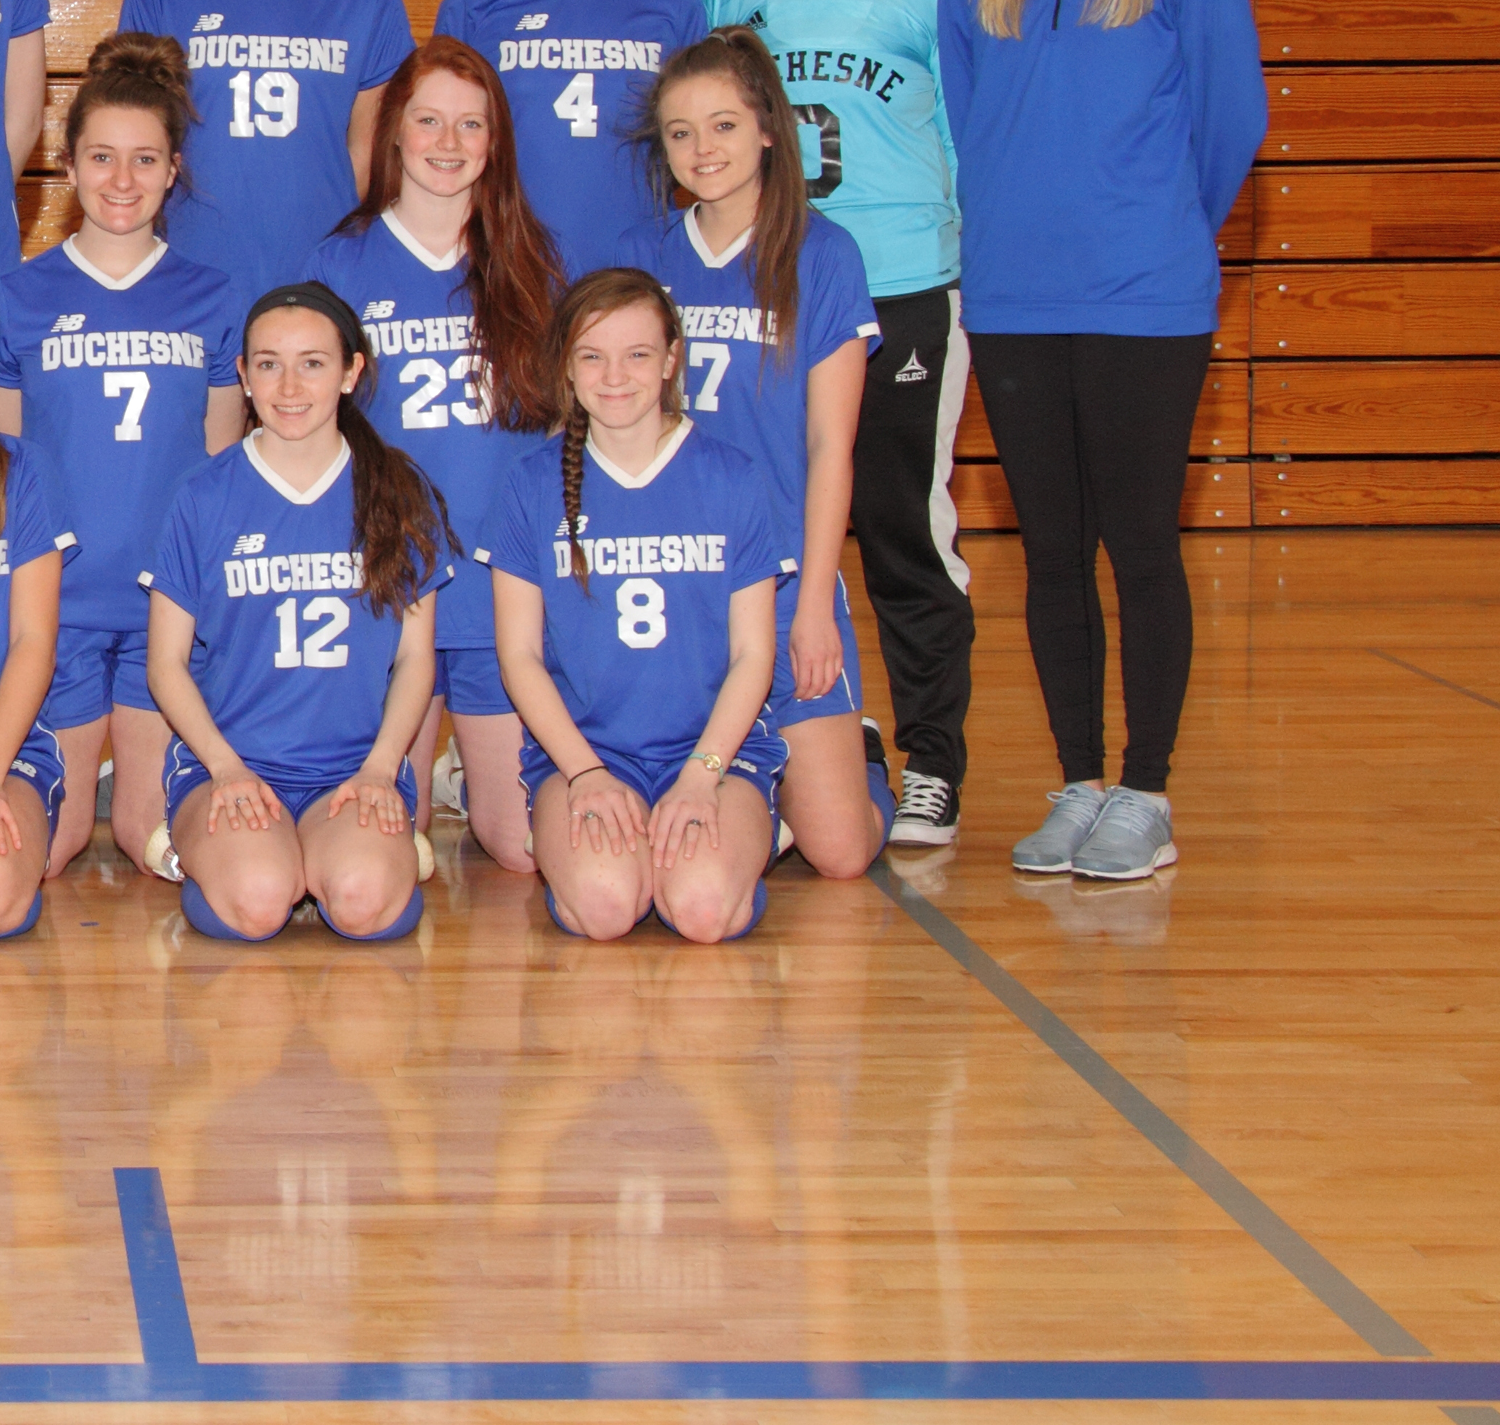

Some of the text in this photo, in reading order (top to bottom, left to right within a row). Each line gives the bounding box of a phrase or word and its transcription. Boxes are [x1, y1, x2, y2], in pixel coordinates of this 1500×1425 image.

[187, 34, 349, 74] DUCHESNE
[499, 38, 662, 73] DUCHESNE
[774, 50, 905, 104] HESNE
[228, 70, 300, 138] 19
[553, 72, 598, 138] 4
[41, 331, 205, 372] DUCHESNE
[678, 341, 731, 412] 7
[895, 370, 928, 383] SELECT
[103, 371, 151, 442] 7
[399, 354, 494, 430] 23
[223, 552, 365, 598] DUCHES
[274, 596, 350, 669] 12
[615, 577, 667, 649] 8
